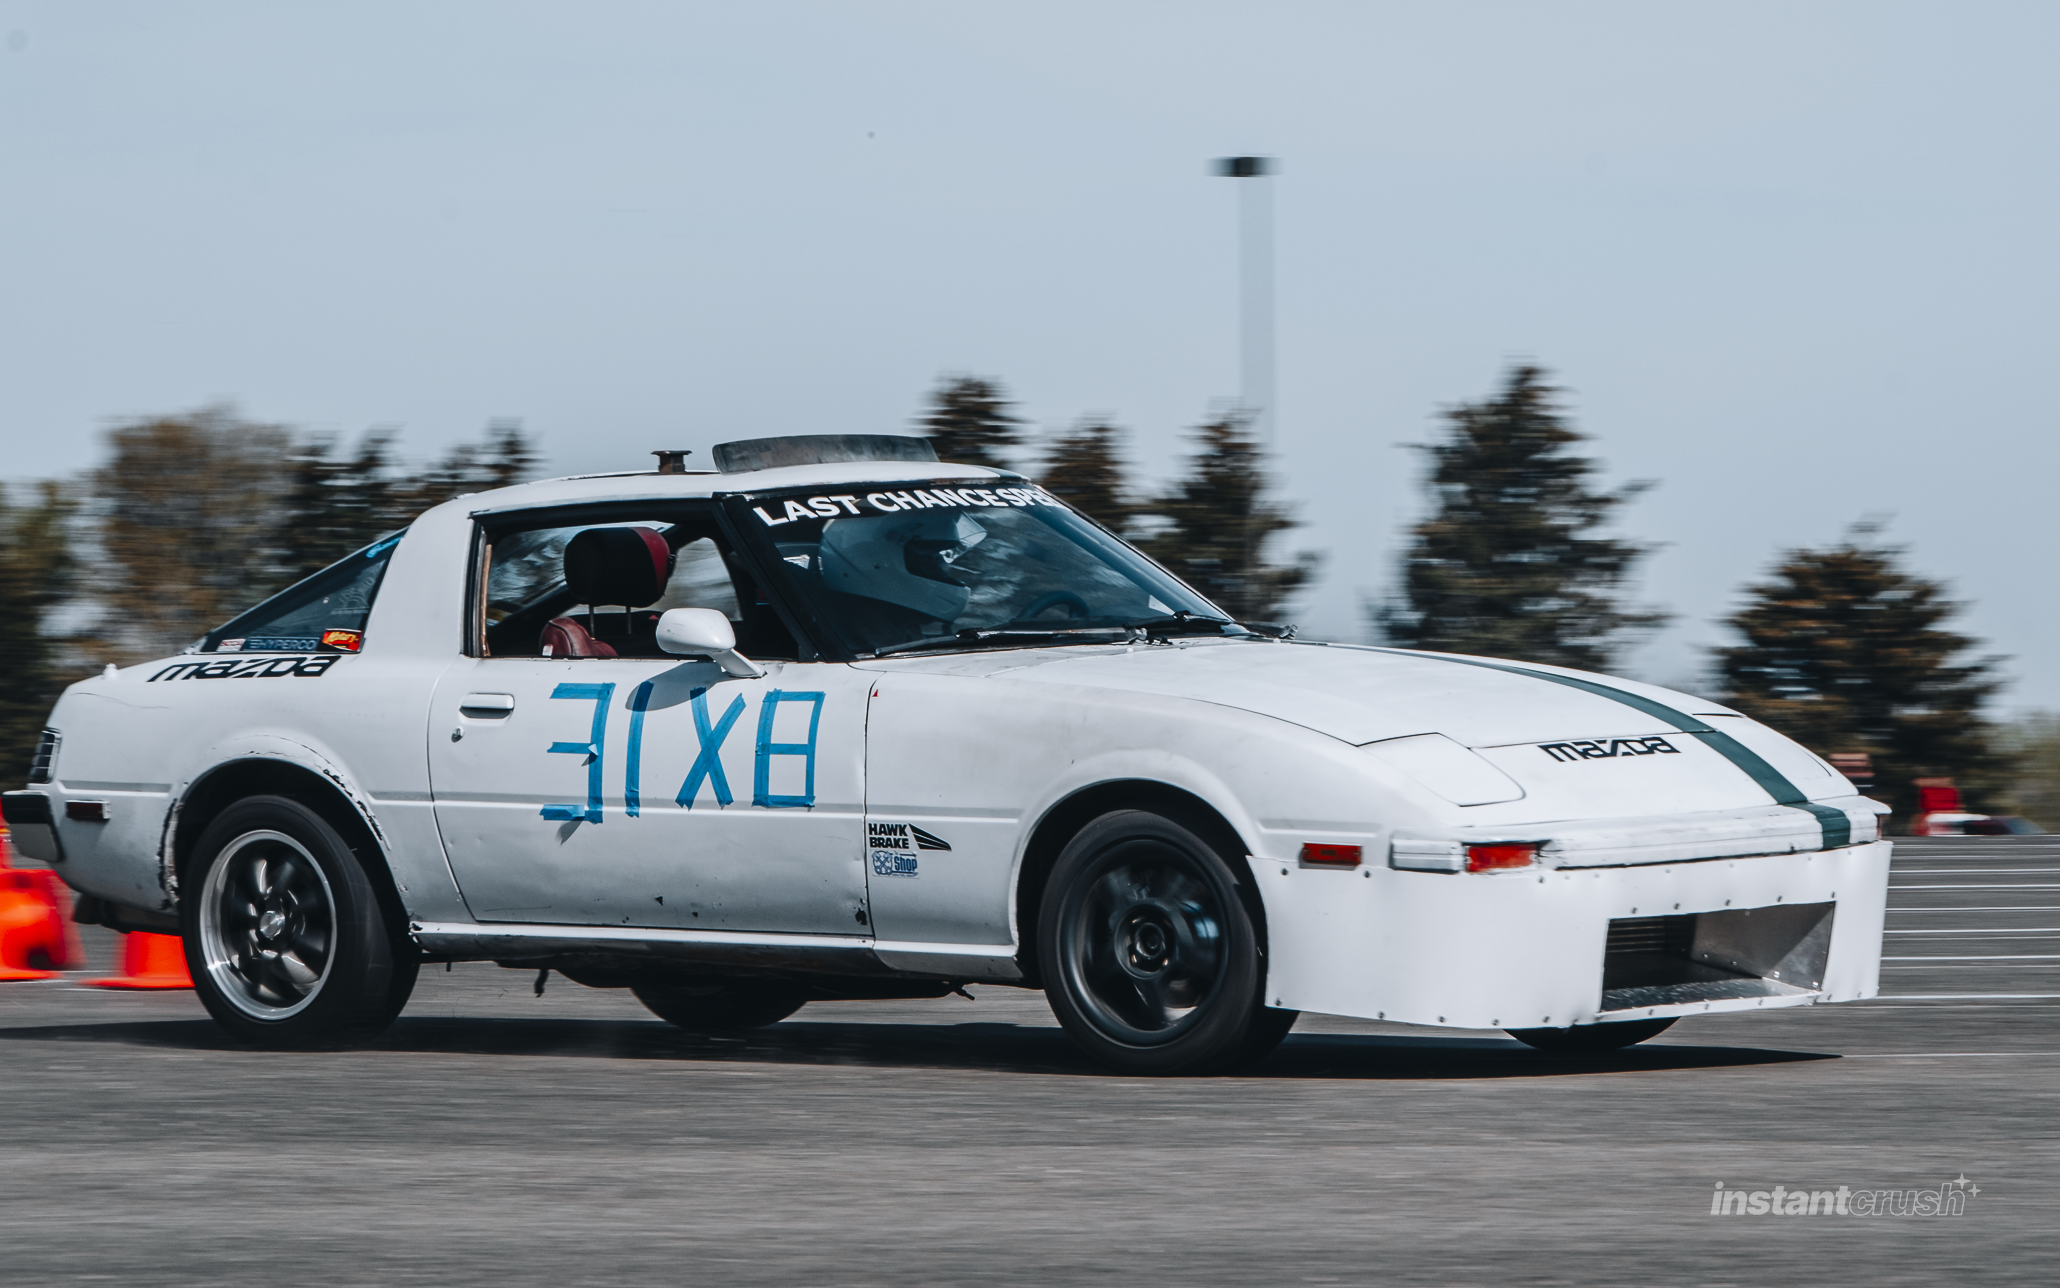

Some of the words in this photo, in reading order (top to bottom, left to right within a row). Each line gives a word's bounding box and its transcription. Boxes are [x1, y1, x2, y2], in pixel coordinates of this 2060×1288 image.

[753, 495, 861, 526] LAST
[866, 488, 1010, 513] CHANCE
[146, 655, 342, 682] mazda
[1537, 736, 1682, 762] mazda
[868, 823, 908, 836] HAWK
[869, 837, 910, 849] BRAKE
